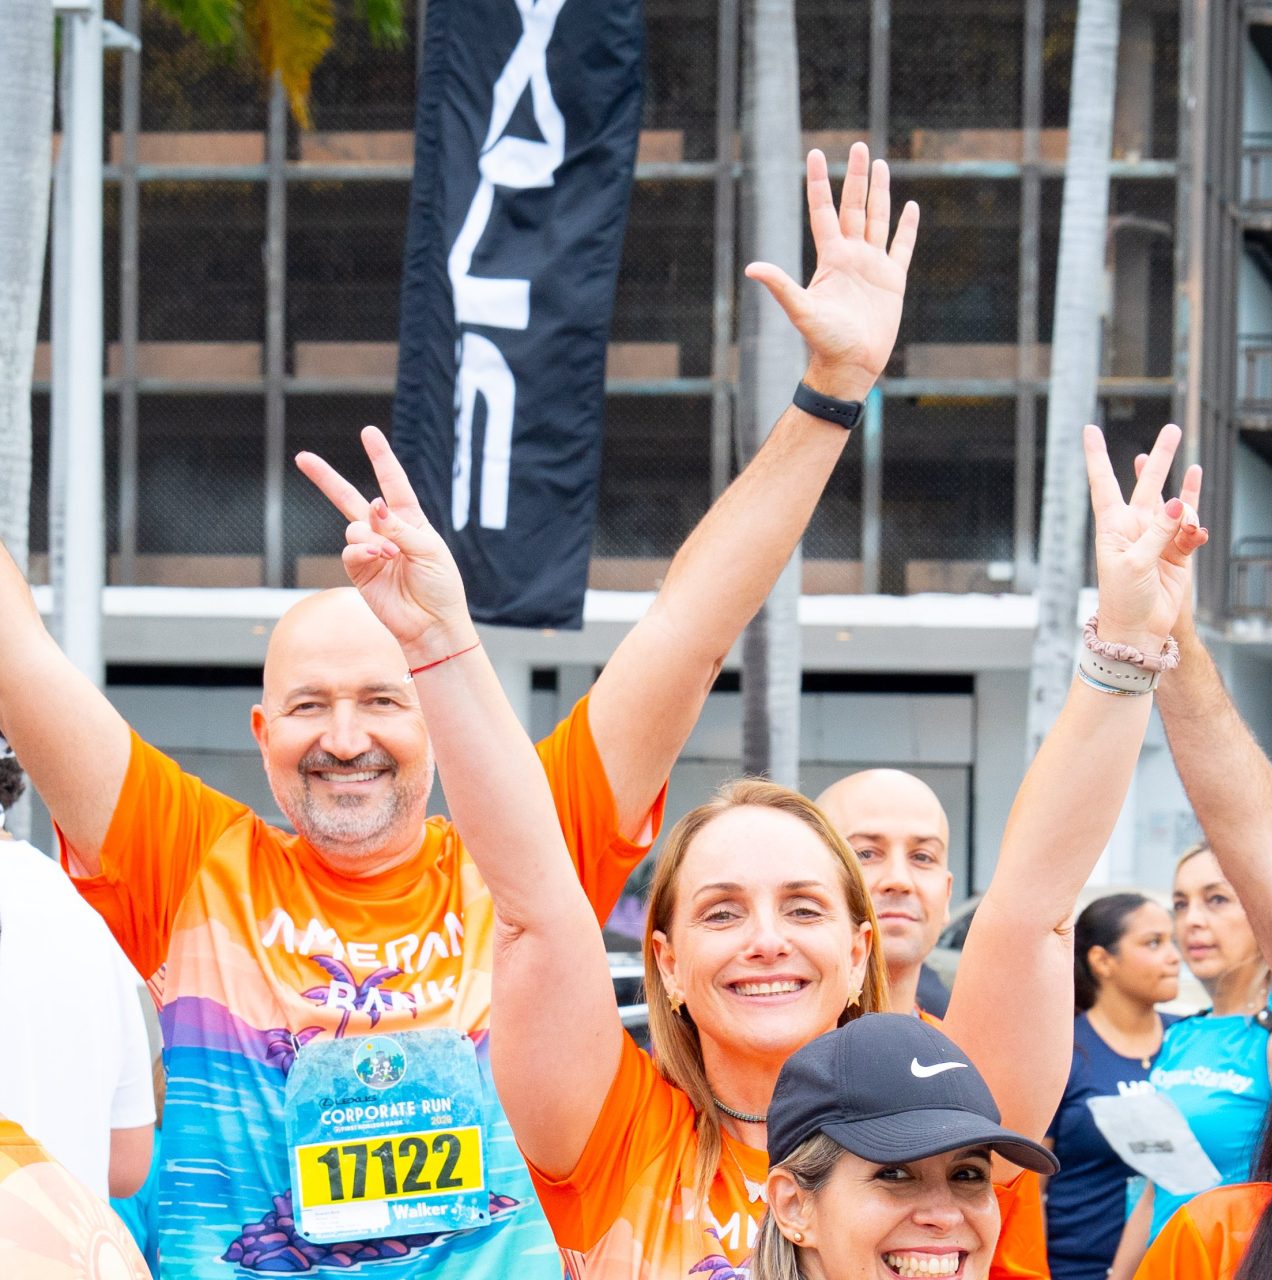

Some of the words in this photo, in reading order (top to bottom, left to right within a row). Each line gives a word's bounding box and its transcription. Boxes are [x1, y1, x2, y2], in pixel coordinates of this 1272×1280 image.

[326, 976, 457, 1013] BANK
[320, 1101, 416, 1126] CORPORATE
[421, 1097, 452, 1114] RUN
[335, 1095, 377, 1106] LEXUS
[317, 1133, 463, 1201] 17122
[393, 1201, 448, 1220] Walker
